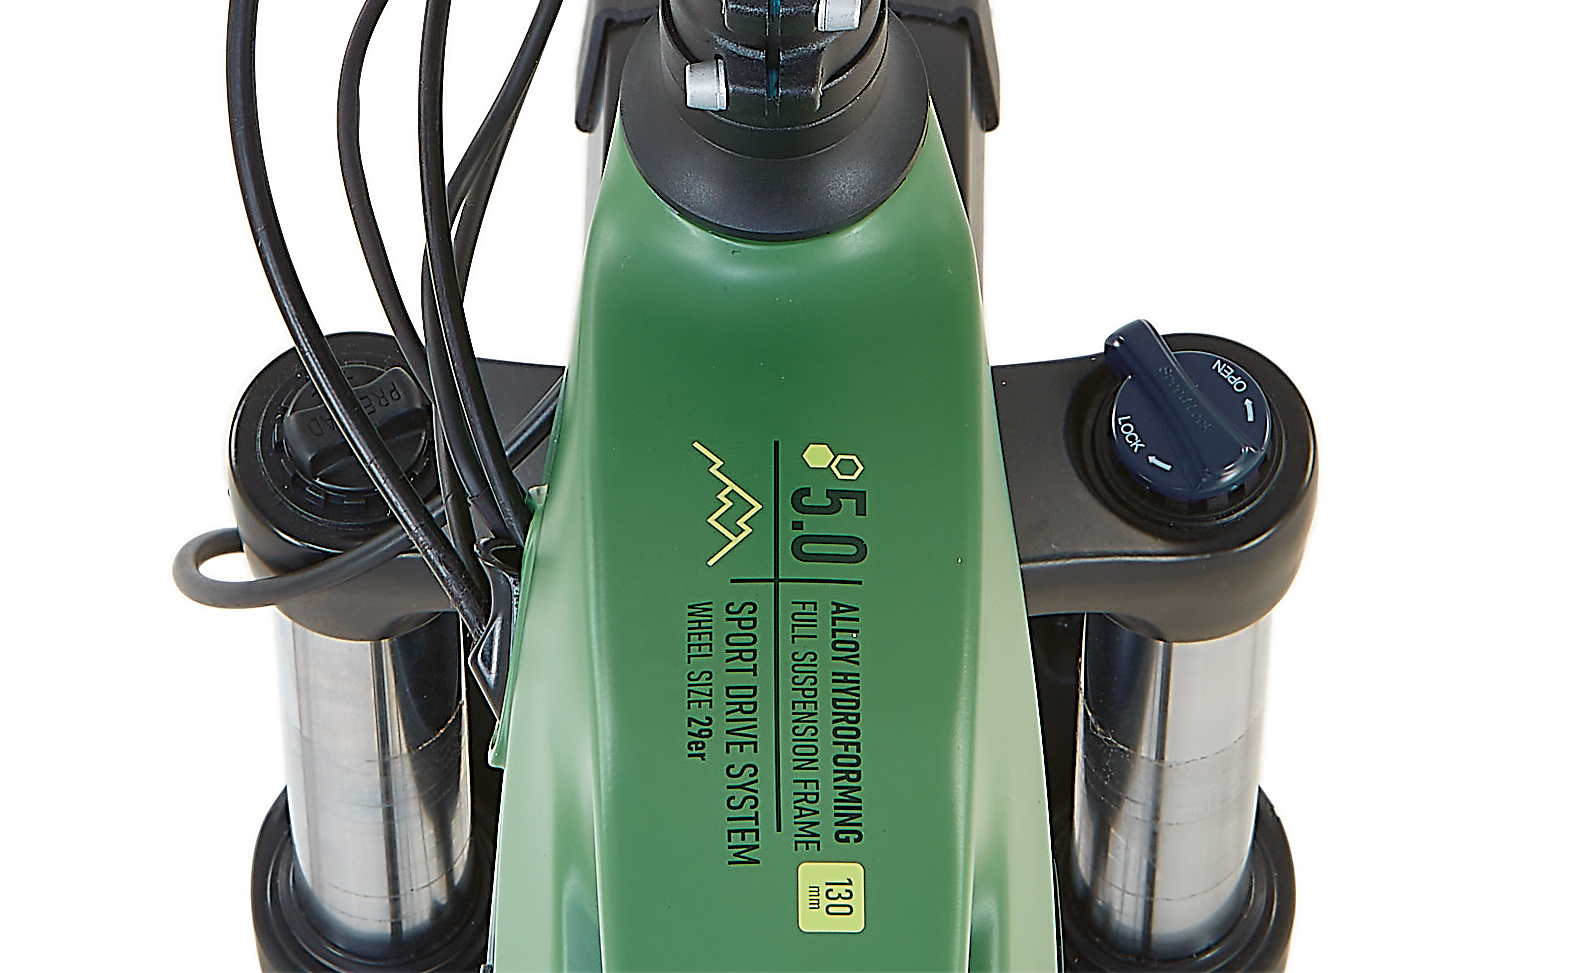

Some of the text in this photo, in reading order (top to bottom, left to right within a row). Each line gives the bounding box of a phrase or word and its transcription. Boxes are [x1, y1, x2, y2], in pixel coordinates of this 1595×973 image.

[1211, 359, 1247, 393] OPEN
[1117, 415, 1146, 453] LOCK
[790, 486, 868, 564] 5.0
[687, 600, 713, 761] WHEEL SIZE 29er
[725, 601, 760, 865] SPORT DRIVE SYSTEM
[791, 600, 821, 852] FULL SUSPENSION FRAME
[831, 600, 863, 844] ALLOY HYDROFORMING
[808, 885, 820, 909] mm
[825, 877, 854, 916] 130
